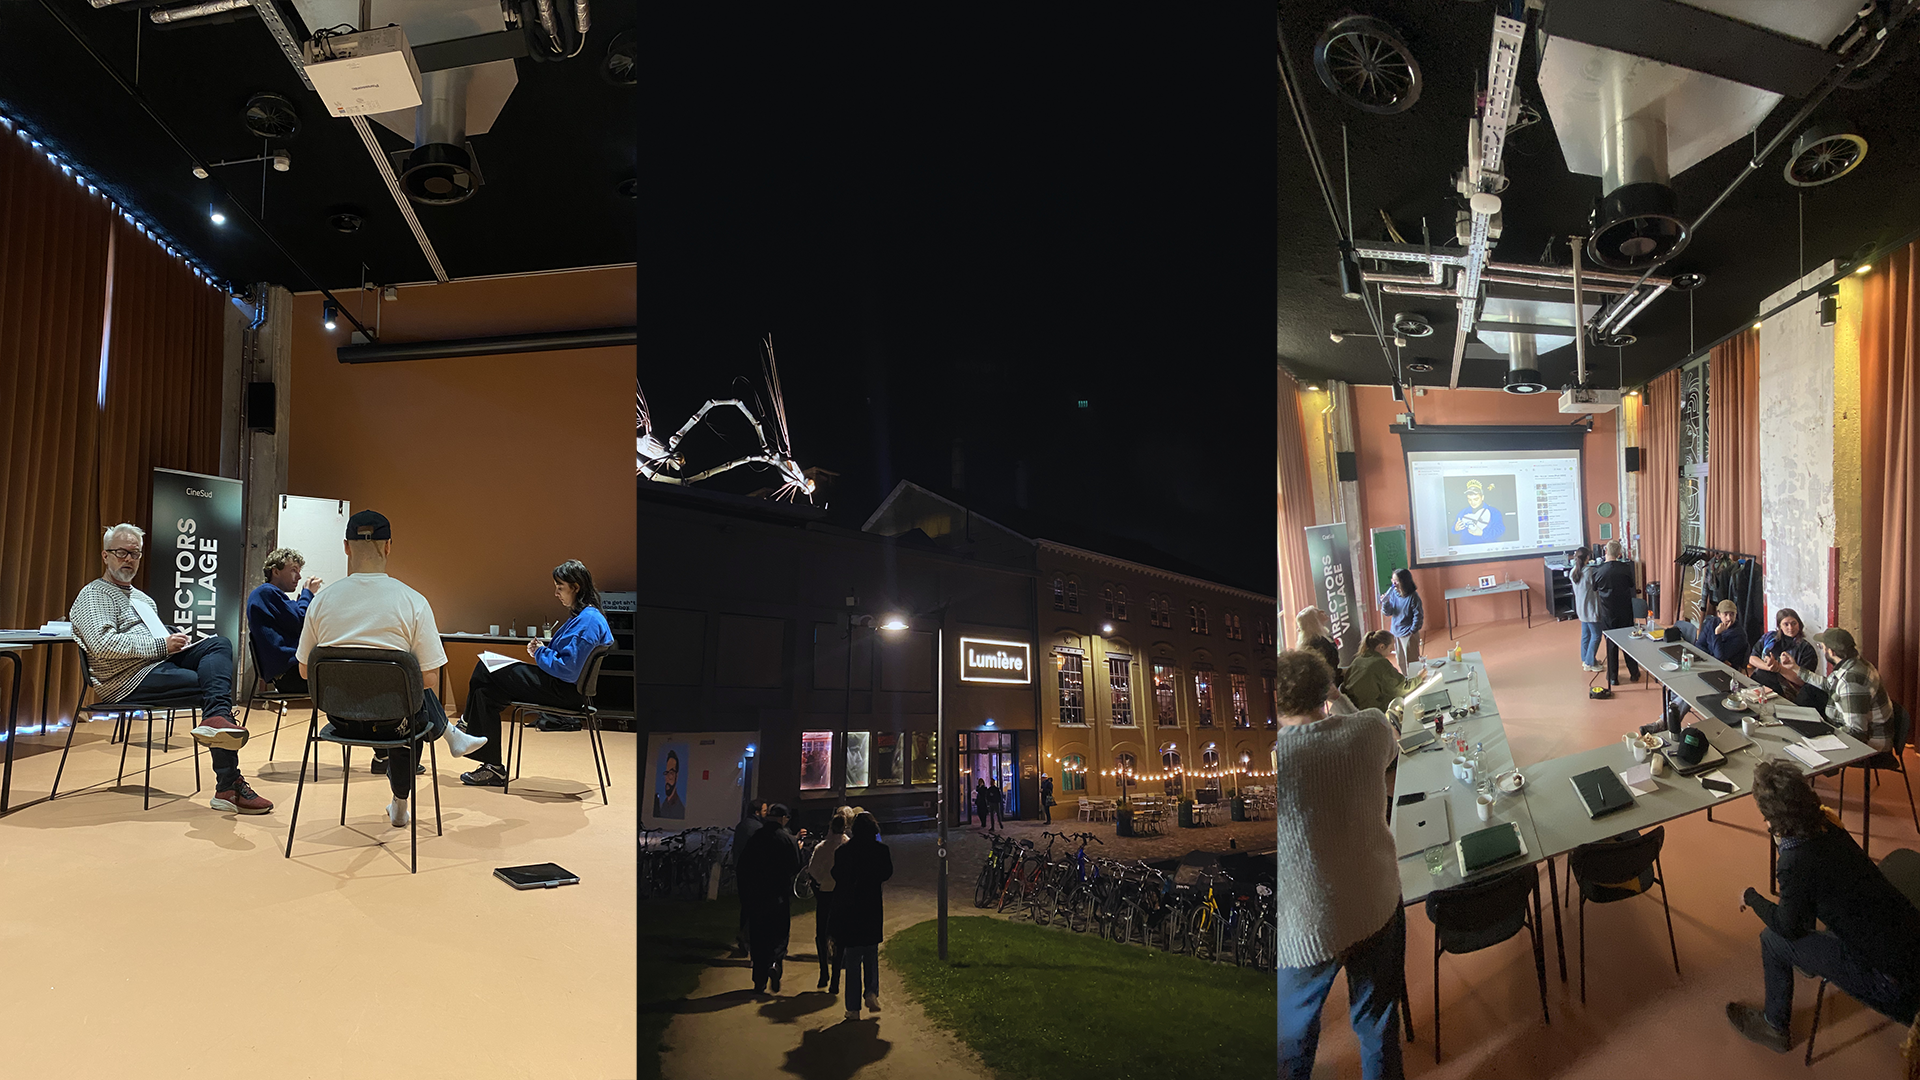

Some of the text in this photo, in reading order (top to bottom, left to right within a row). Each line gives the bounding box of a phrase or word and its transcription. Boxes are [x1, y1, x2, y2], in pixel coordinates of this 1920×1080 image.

[186, 487, 213, 499] CineSud
[174, 518, 197, 644] RECTORS
[1333, 563, 1351, 634] VILLAGE
[968, 648, 1024, 671] Lumière
